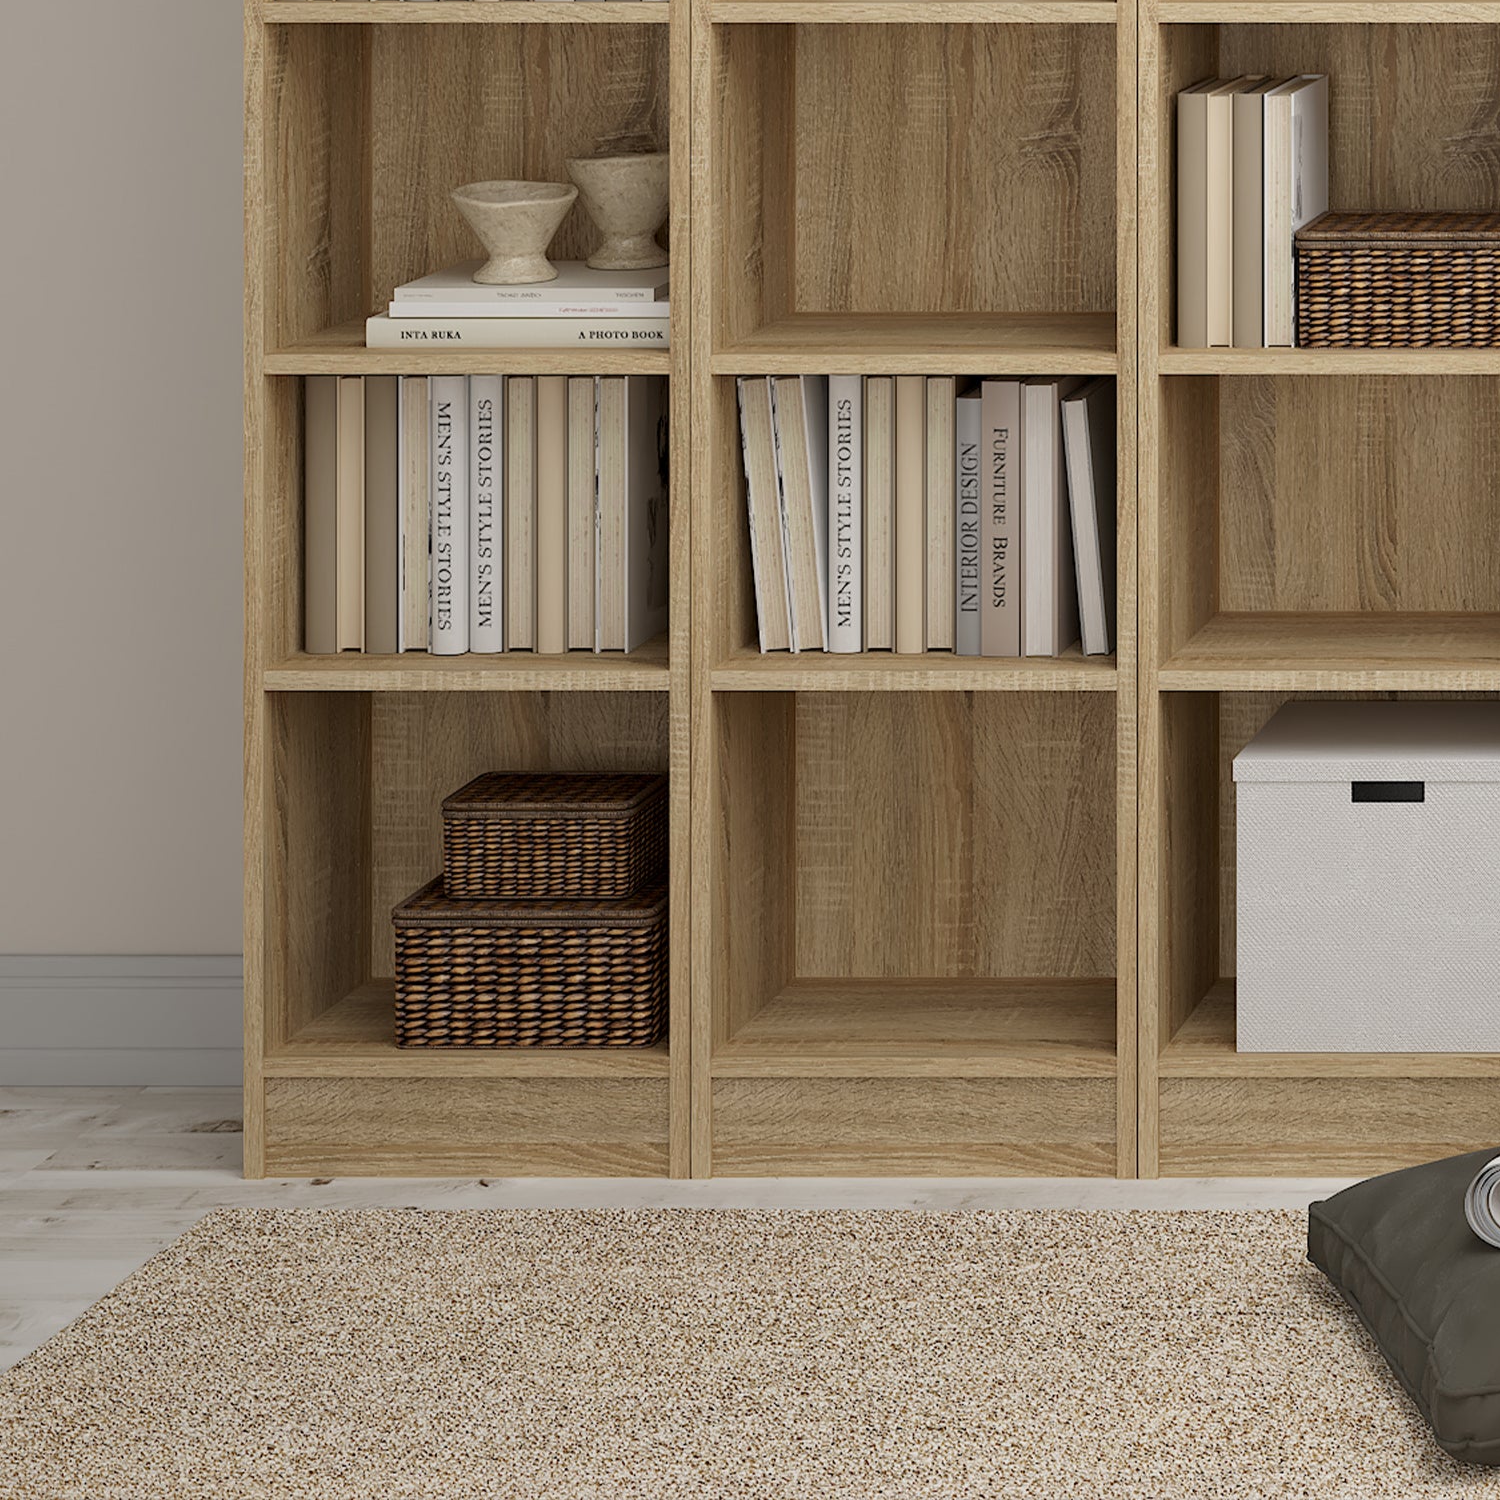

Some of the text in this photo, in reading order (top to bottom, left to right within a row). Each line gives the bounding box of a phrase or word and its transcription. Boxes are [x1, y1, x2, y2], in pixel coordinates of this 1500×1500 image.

[400, 330, 462, 340] INTA RUKA
[578, 330, 665, 340] A PHOTO BOOK
[437, 401, 452, 632] MEN'S STYLE STORIES
[478, 398, 493, 628] MEN'S STYLE STORIES
[837, 398, 852, 628] MEN'S STYLE STORIES
[961, 442, 979, 613] INTERIOR DESIGN
[992, 427, 1009, 609] FURNITURE BRANDS
